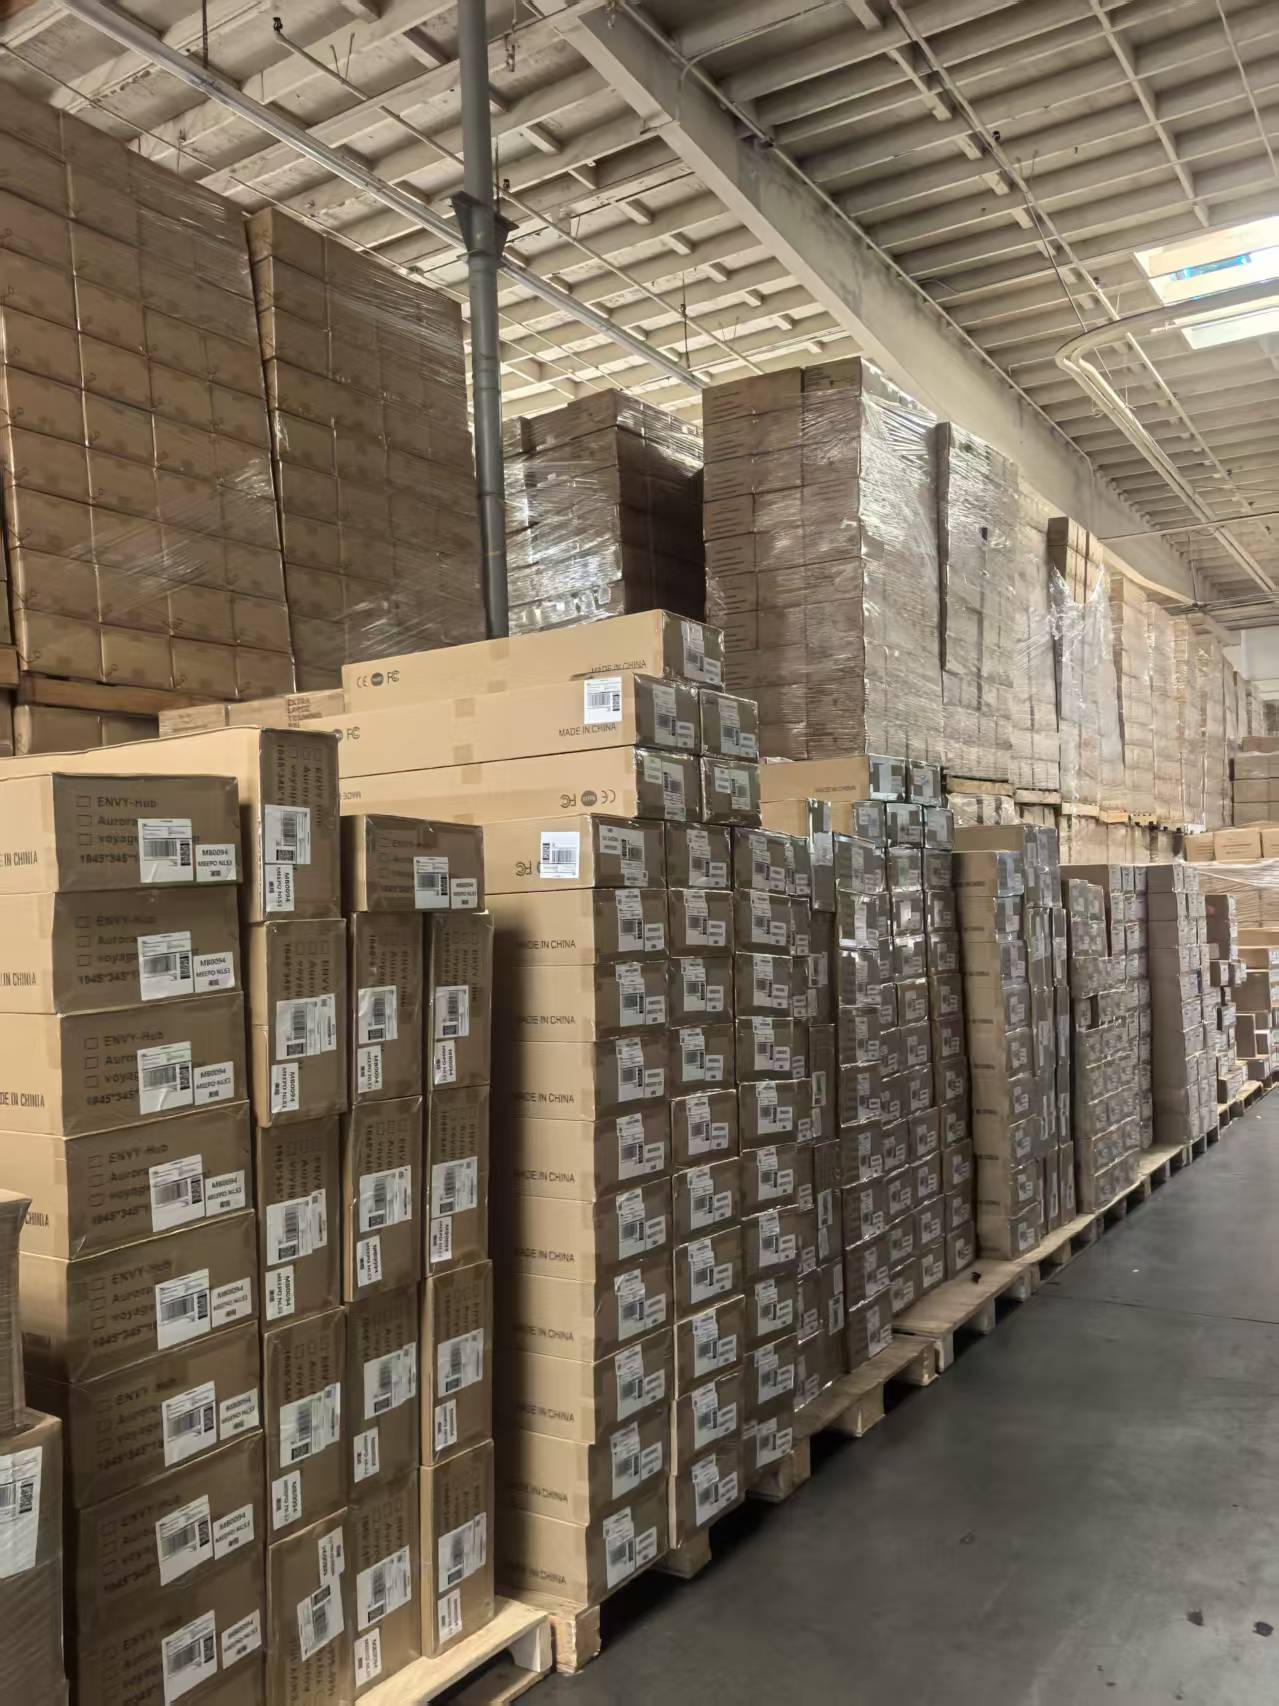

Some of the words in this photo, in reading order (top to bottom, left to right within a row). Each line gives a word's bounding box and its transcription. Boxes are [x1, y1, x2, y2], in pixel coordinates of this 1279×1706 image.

[558, 728, 580, 737] MADE
[582, 726, 590, 734] IN
[592, 723, 616, 734] CHINA
[541, 940, 549, 948] IN
[550, 939, 576, 949] CHINA
[540, 1016, 549, 1024] IN
[550, 1015, 576, 1024] CHINA
[539, 1094, 547, 1102] IN
[548, 1093, 574, 1104] CHINA
[548, 1172, 576, 1183] CHINA
[548, 1251, 575, 1263] CHINA
